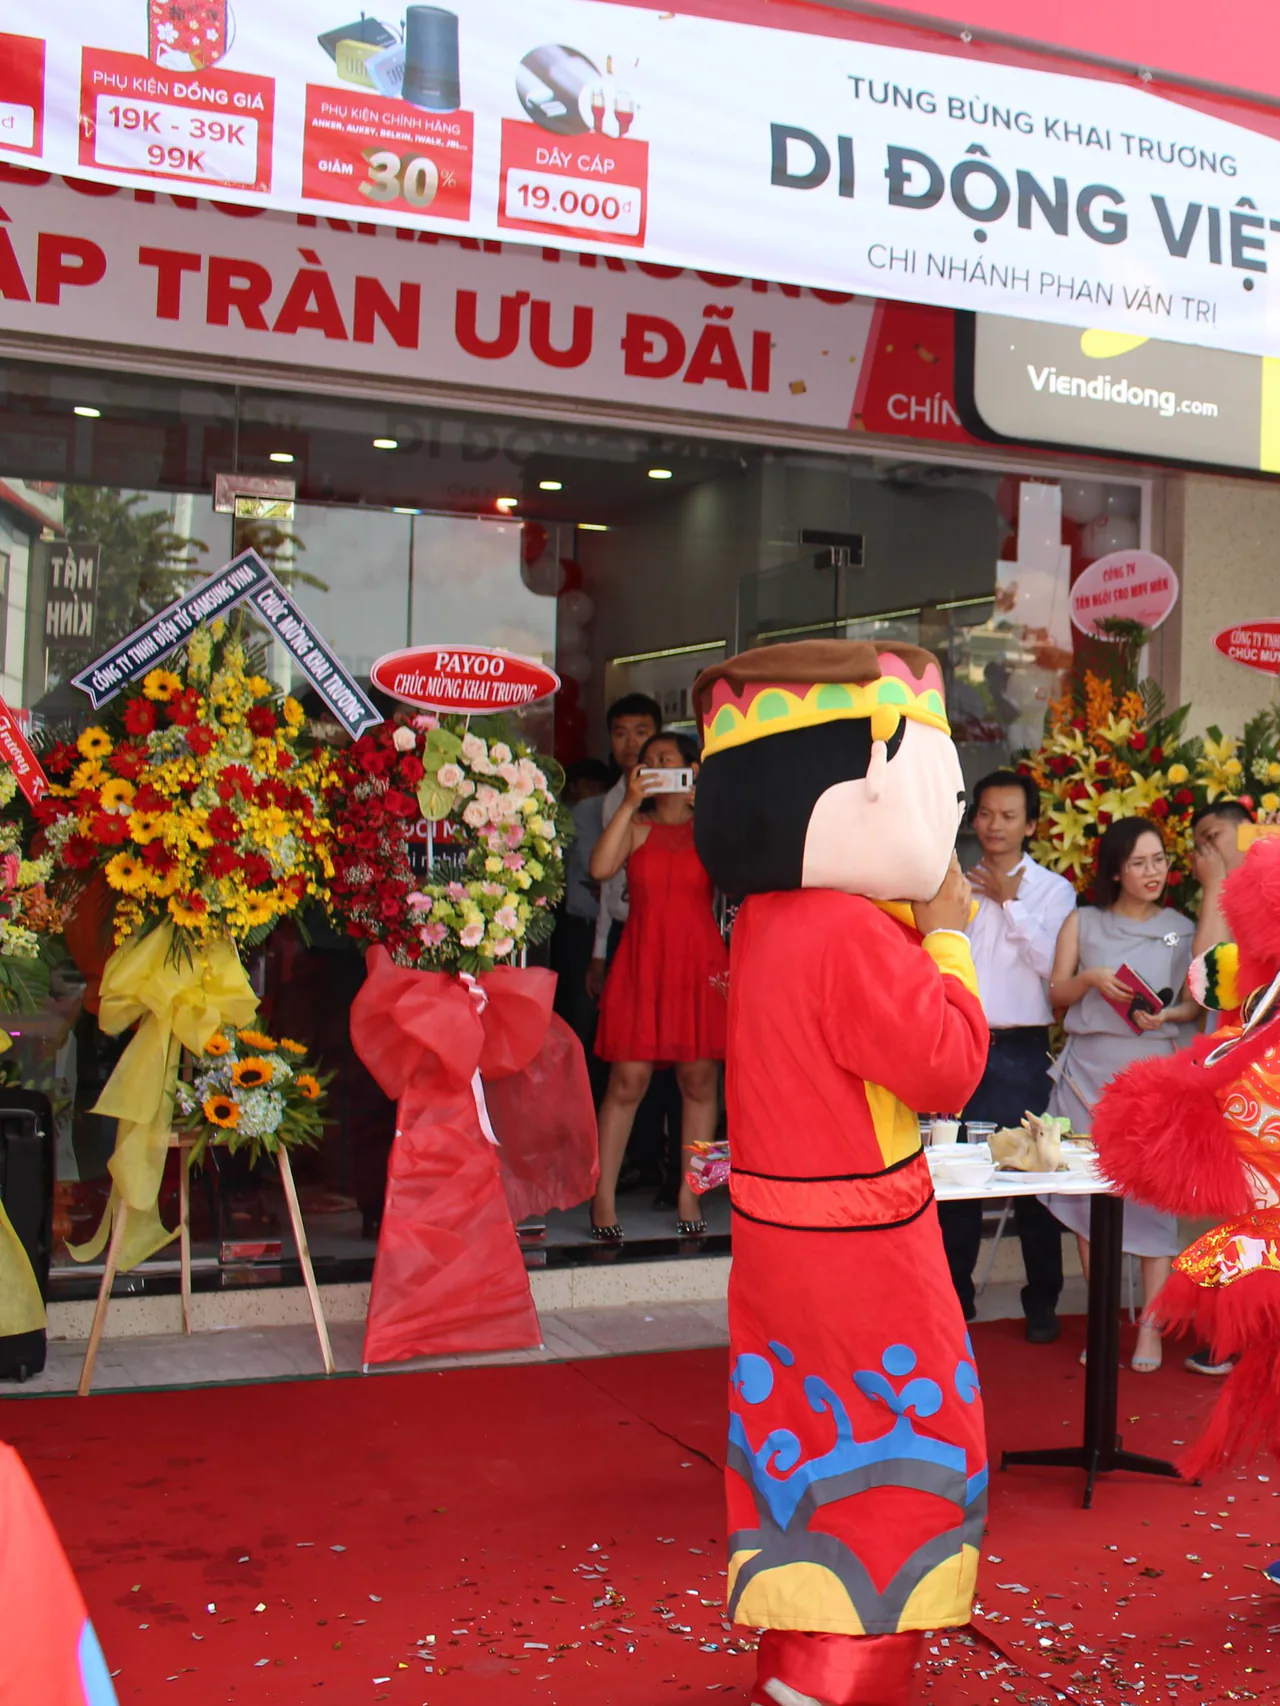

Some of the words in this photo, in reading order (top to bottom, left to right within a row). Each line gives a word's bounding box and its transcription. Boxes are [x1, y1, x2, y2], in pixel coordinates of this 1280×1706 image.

[93, 70, 128, 92] PHỤ
[133, 77, 169, 97] KIỆN
[173, 81, 229, 105] ĐỒNG
[233, 91, 265, 111] GIÁ
[108, 105, 162, 134] 19K
[189, 118, 245, 146] 39K
[321, 102, 348, 118] PHỤ
[351, 106, 379, 123] KIỆN
[382, 112, 421, 129] CHÍNH
[425, 118, 461, 135] HÀNG
[848, 74, 937, 115] TƯNG
[947, 95, 1034, 134] BỪNG
[1044, 117, 1112, 151] KHAI
[1120, 133, 1238, 177] TRƯƠNG
[147, 144, 205, 172] 99K
[535, 146, 573, 168] DÂY
[577, 154, 615, 174] CÁP
[770, 121, 855, 198] DI
[884, 142, 1128, 245] ĐỘNG
[867, 243, 916, 274] CHI
[926, 252, 1030, 293] NHÁNH
[1040, 272, 1114, 307] PHAN
[1122, 284, 1173, 316] VĂN
[1181, 296, 1218, 329] TRỊ
[138, 247, 422, 350] TRÀN
[455, 289, 594, 369] ƯU
[620, 304, 772, 394] ĐÃI
[1027, 363, 1219, 418] Viendidong.com
[92, 658, 122, 692] CÔNG
[116, 654, 135, 674] TY
[127, 638, 159, 666] TNHH
[152, 621, 181, 648] ĐIỆN
[188, 580, 235, 621] SAMSUNG
[228, 563, 257, 591] VINA
[257, 588, 289, 622] CHÚC
[277, 614, 314, 656] MỪNG
[303, 647, 334, 681] KHAI
[323, 673, 366, 723] TRƯƠNG
[434, 651, 505, 677] PAYOO
[1228, 646, 1258, 661] CHÚC
[394, 669, 426, 696] CHÚC
[425, 672, 462, 699] MỪNG
[461, 678, 489, 701] KHAI
[490, 681, 538, 704] TRƯƠNG
